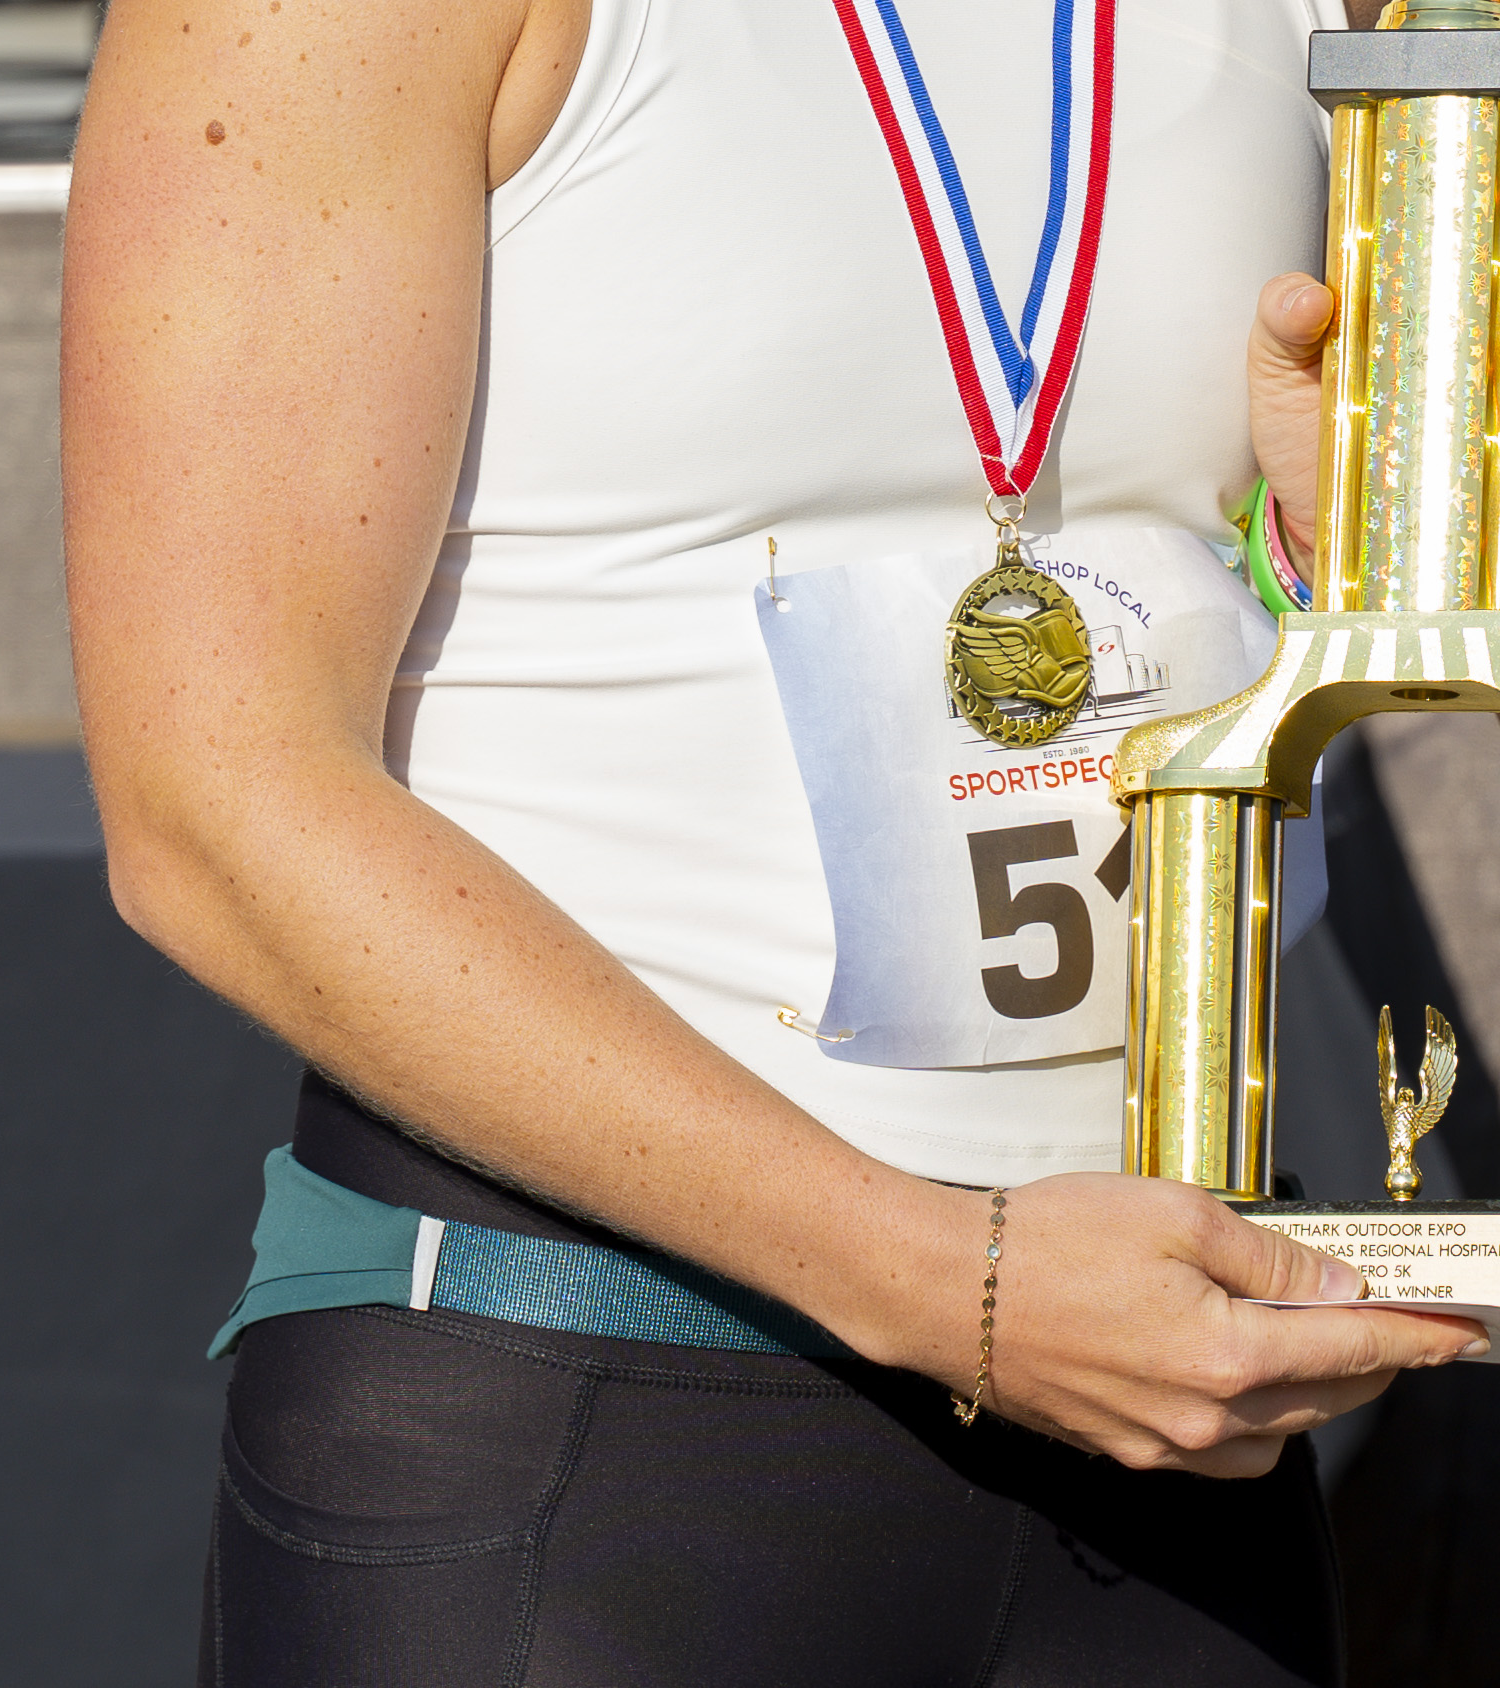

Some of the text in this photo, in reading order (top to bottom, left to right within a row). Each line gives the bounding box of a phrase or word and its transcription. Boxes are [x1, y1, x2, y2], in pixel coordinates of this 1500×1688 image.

[1033, 559, 1151, 630] SHOP LOCAL
[967, 819, 1132, 1020] 5
[1346, 1223, 1422, 1237] OUTDOOR
[1428, 1223, 1466, 1237] EXPO
[1360, 1244, 1434, 1257] REGIONAL
[1358, 1264, 1411, 1278] ERO 5K
[1397, 1286, 1454, 1299] WINNER
